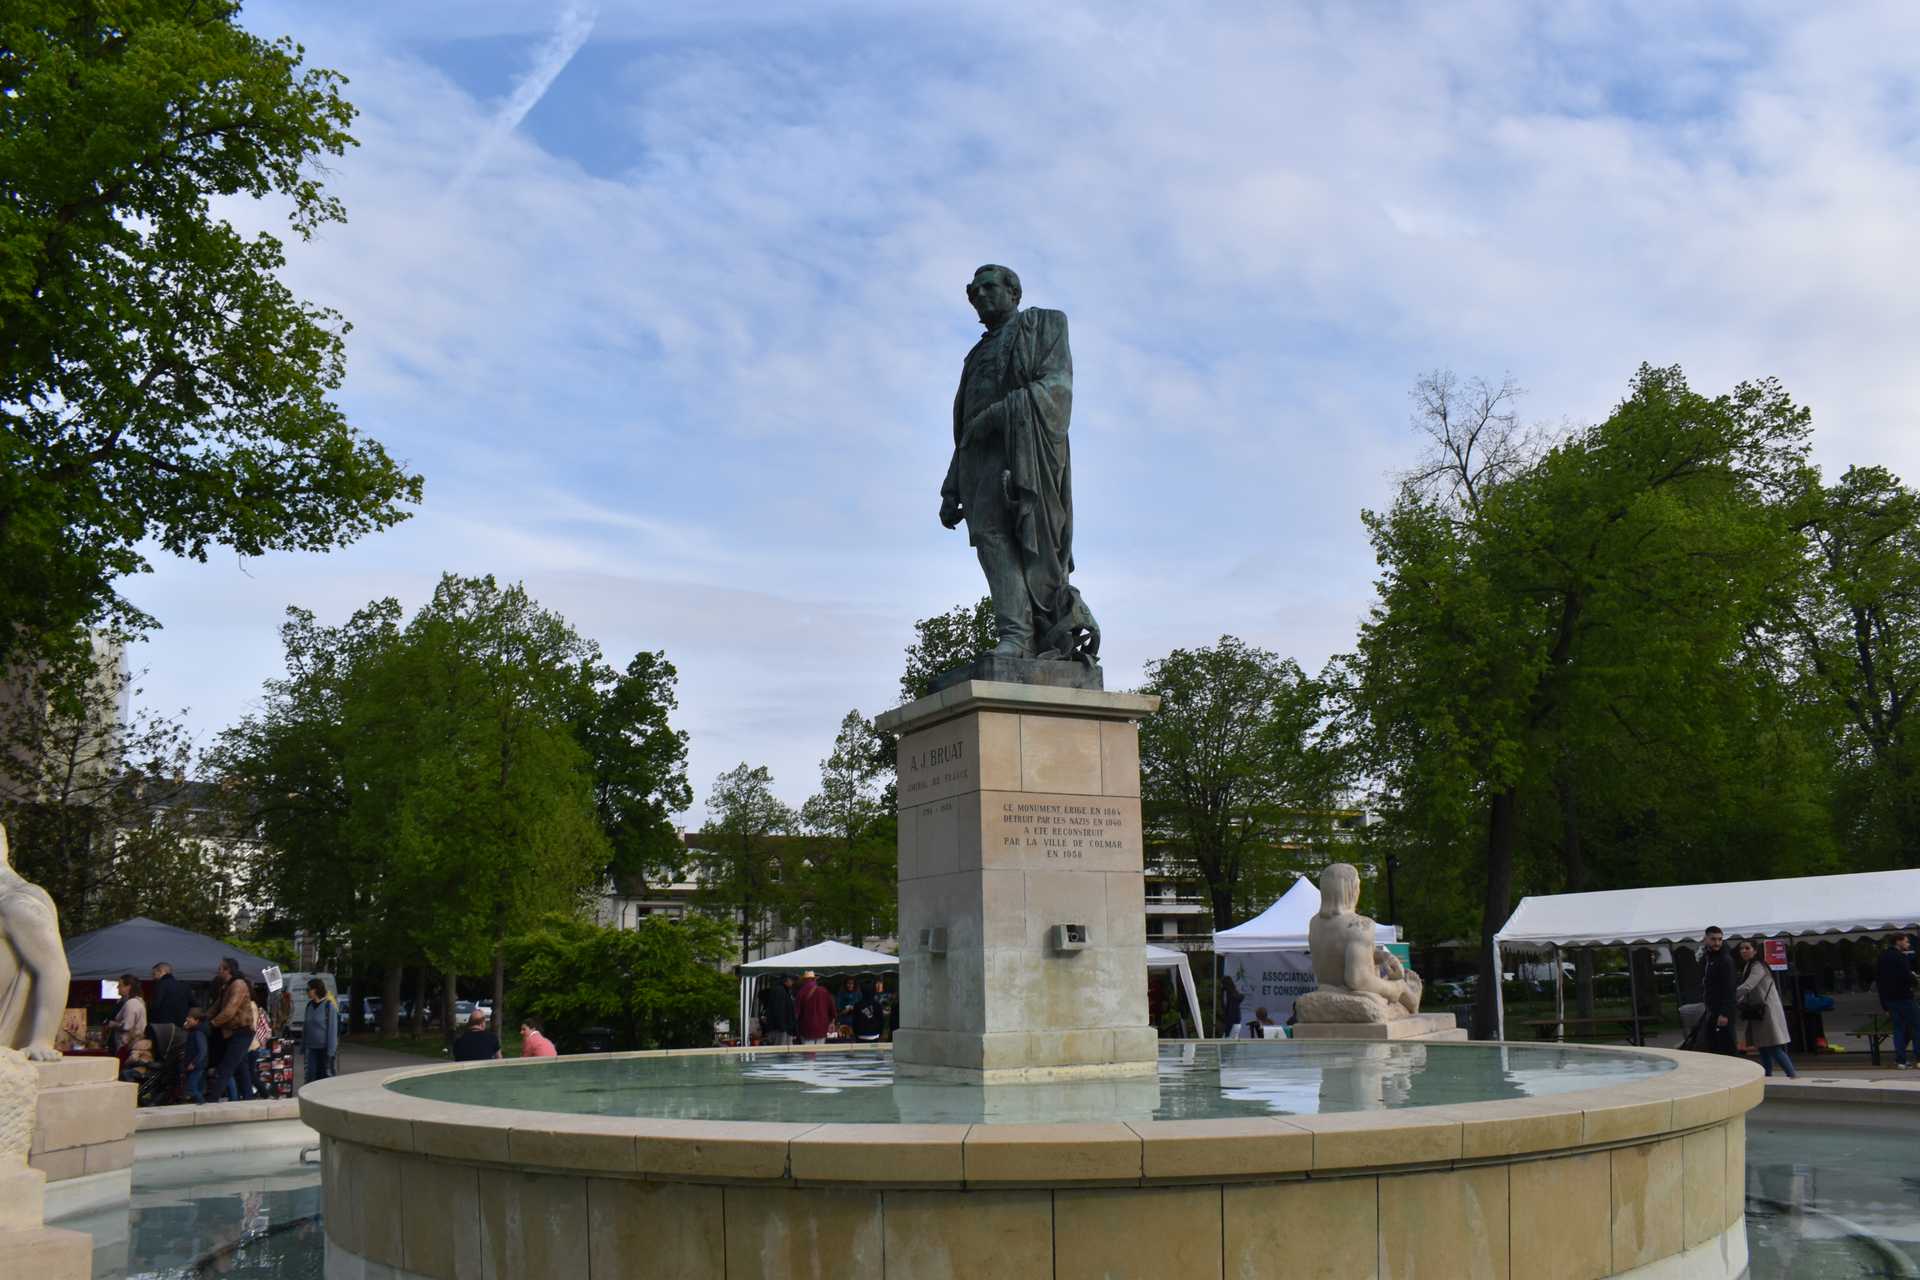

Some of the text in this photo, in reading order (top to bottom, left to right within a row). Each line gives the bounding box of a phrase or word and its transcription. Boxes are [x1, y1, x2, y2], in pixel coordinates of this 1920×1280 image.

[930, 741, 963, 767] BRUAT
[1003, 803, 1013, 812] LE
[1017, 803, 1060, 814] MONUMENT
[1090, 806, 1101, 816] EN
[1037, 815, 1050, 825] PAR
[1053, 816, 1066, 825] LES
[1069, 817, 1089, 826] NAZIS
[1093, 817, 1103, 826] EN
[1052, 827, 1104, 837] RECONSTRUIT
[1004, 837, 1122, 849] PAR LA VILLE DE COLMAR
[1047, 850, 1058, 858] EN
[1262, 971, 1315, 982] ASSOCIATION
[1262, 985, 1272, 996] ET
